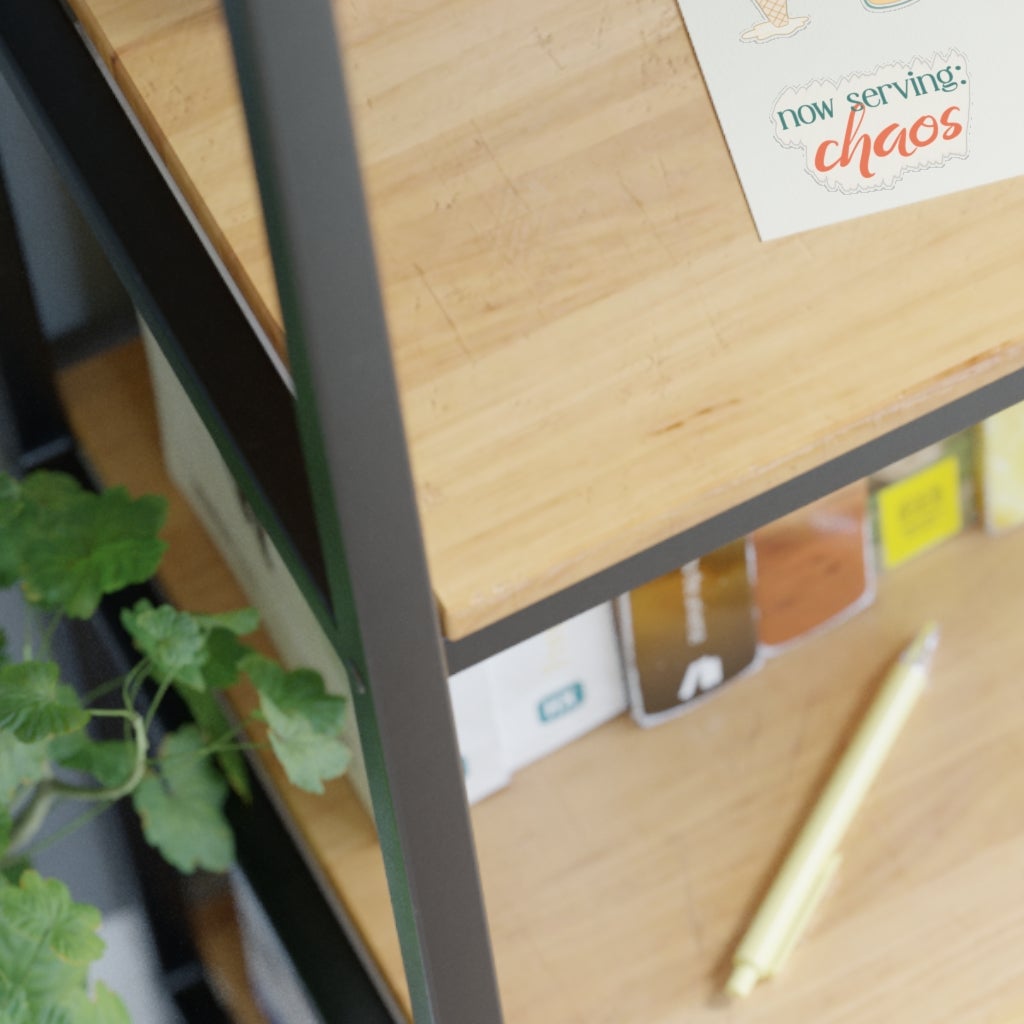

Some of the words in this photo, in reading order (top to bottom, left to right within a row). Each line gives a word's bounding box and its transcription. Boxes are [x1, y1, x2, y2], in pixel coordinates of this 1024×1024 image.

[777, 98, 834, 130] now
[846, 65, 967, 112] serving:
[814, 105, 963, 179] chaos
